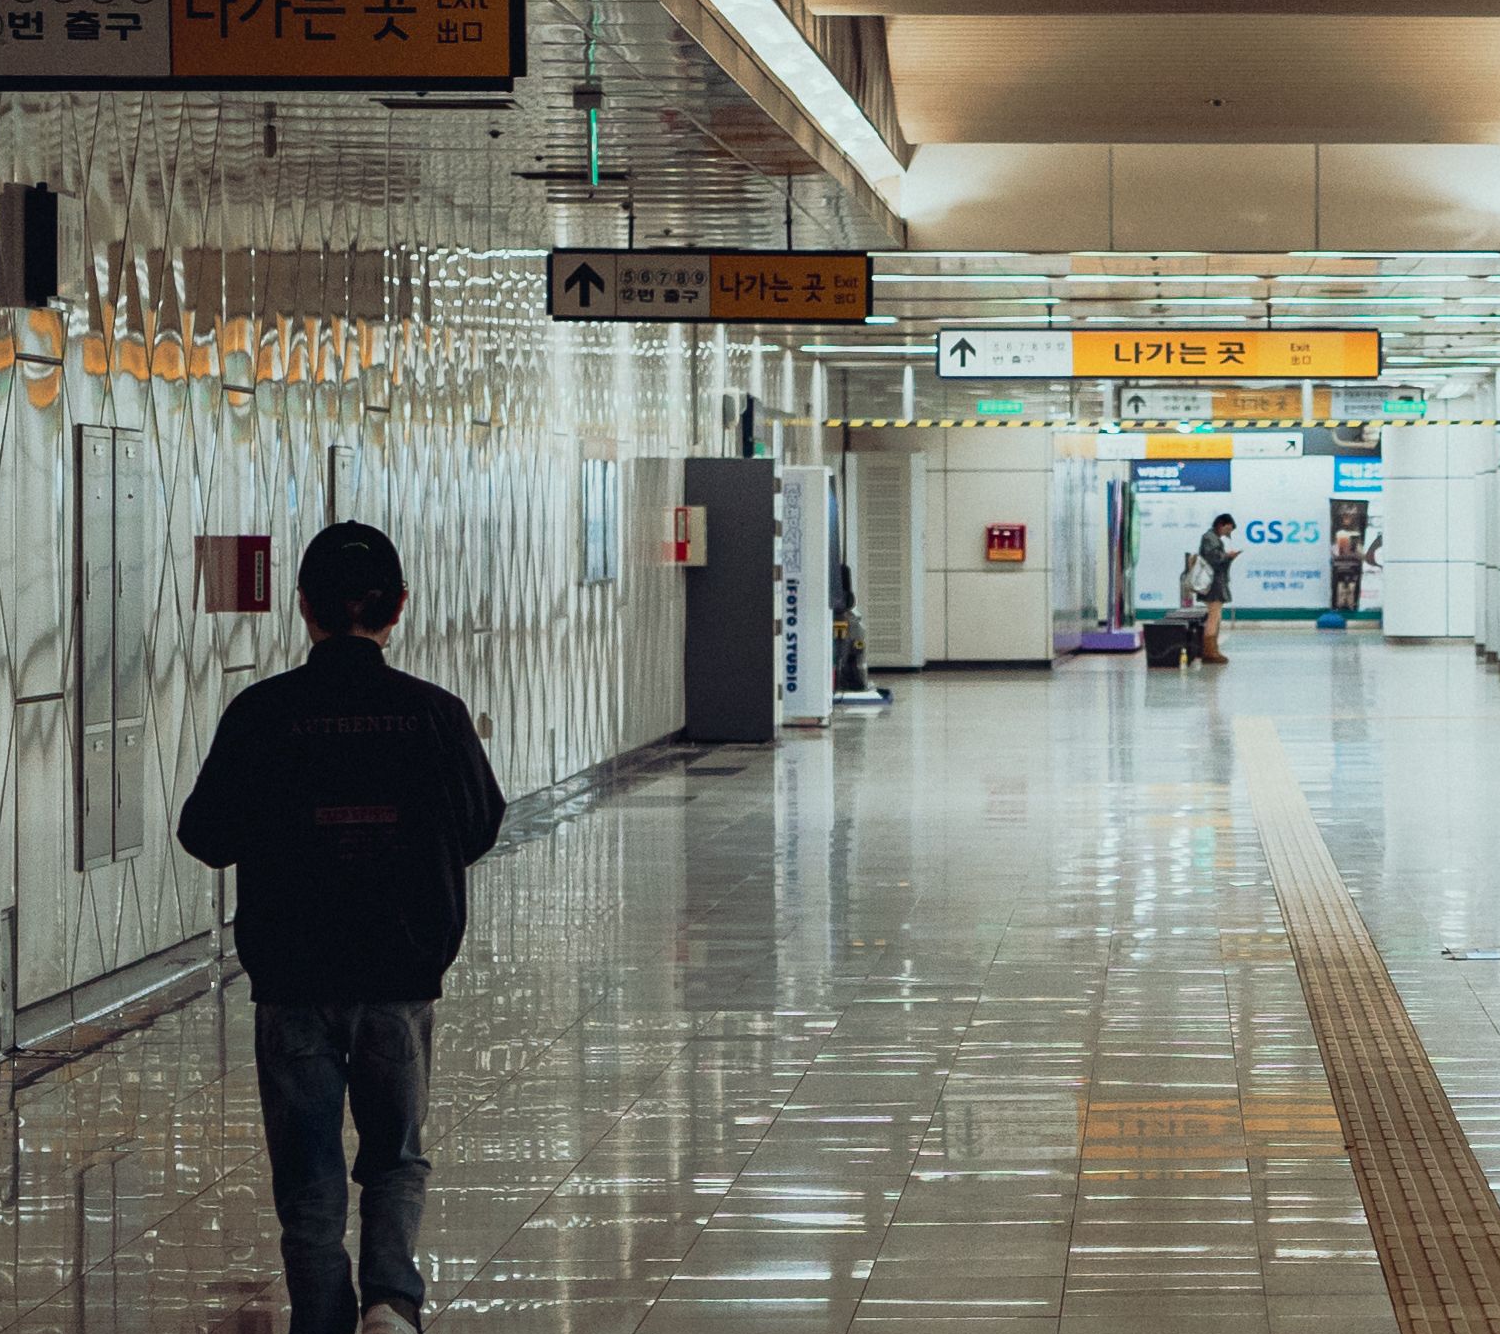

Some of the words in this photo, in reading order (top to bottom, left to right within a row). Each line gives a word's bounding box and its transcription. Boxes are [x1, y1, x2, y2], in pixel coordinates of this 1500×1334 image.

[63, 11, 144, 43] 출구
[436, 20, 484, 45] 出口
[720, 272, 793, 303] 나가는
[800, 273, 825, 302] 곳
[834, 275, 859, 289] Exit
[662, 288, 700, 304] 출구
[1113, 341, 1208, 366] 나가는
[1217, 341, 1247, 366] 곳
[1289, 342, 1311, 354] Exit
[1245, 520, 1320, 544] GS25
[786, 632, 798, 693] STUDIO
